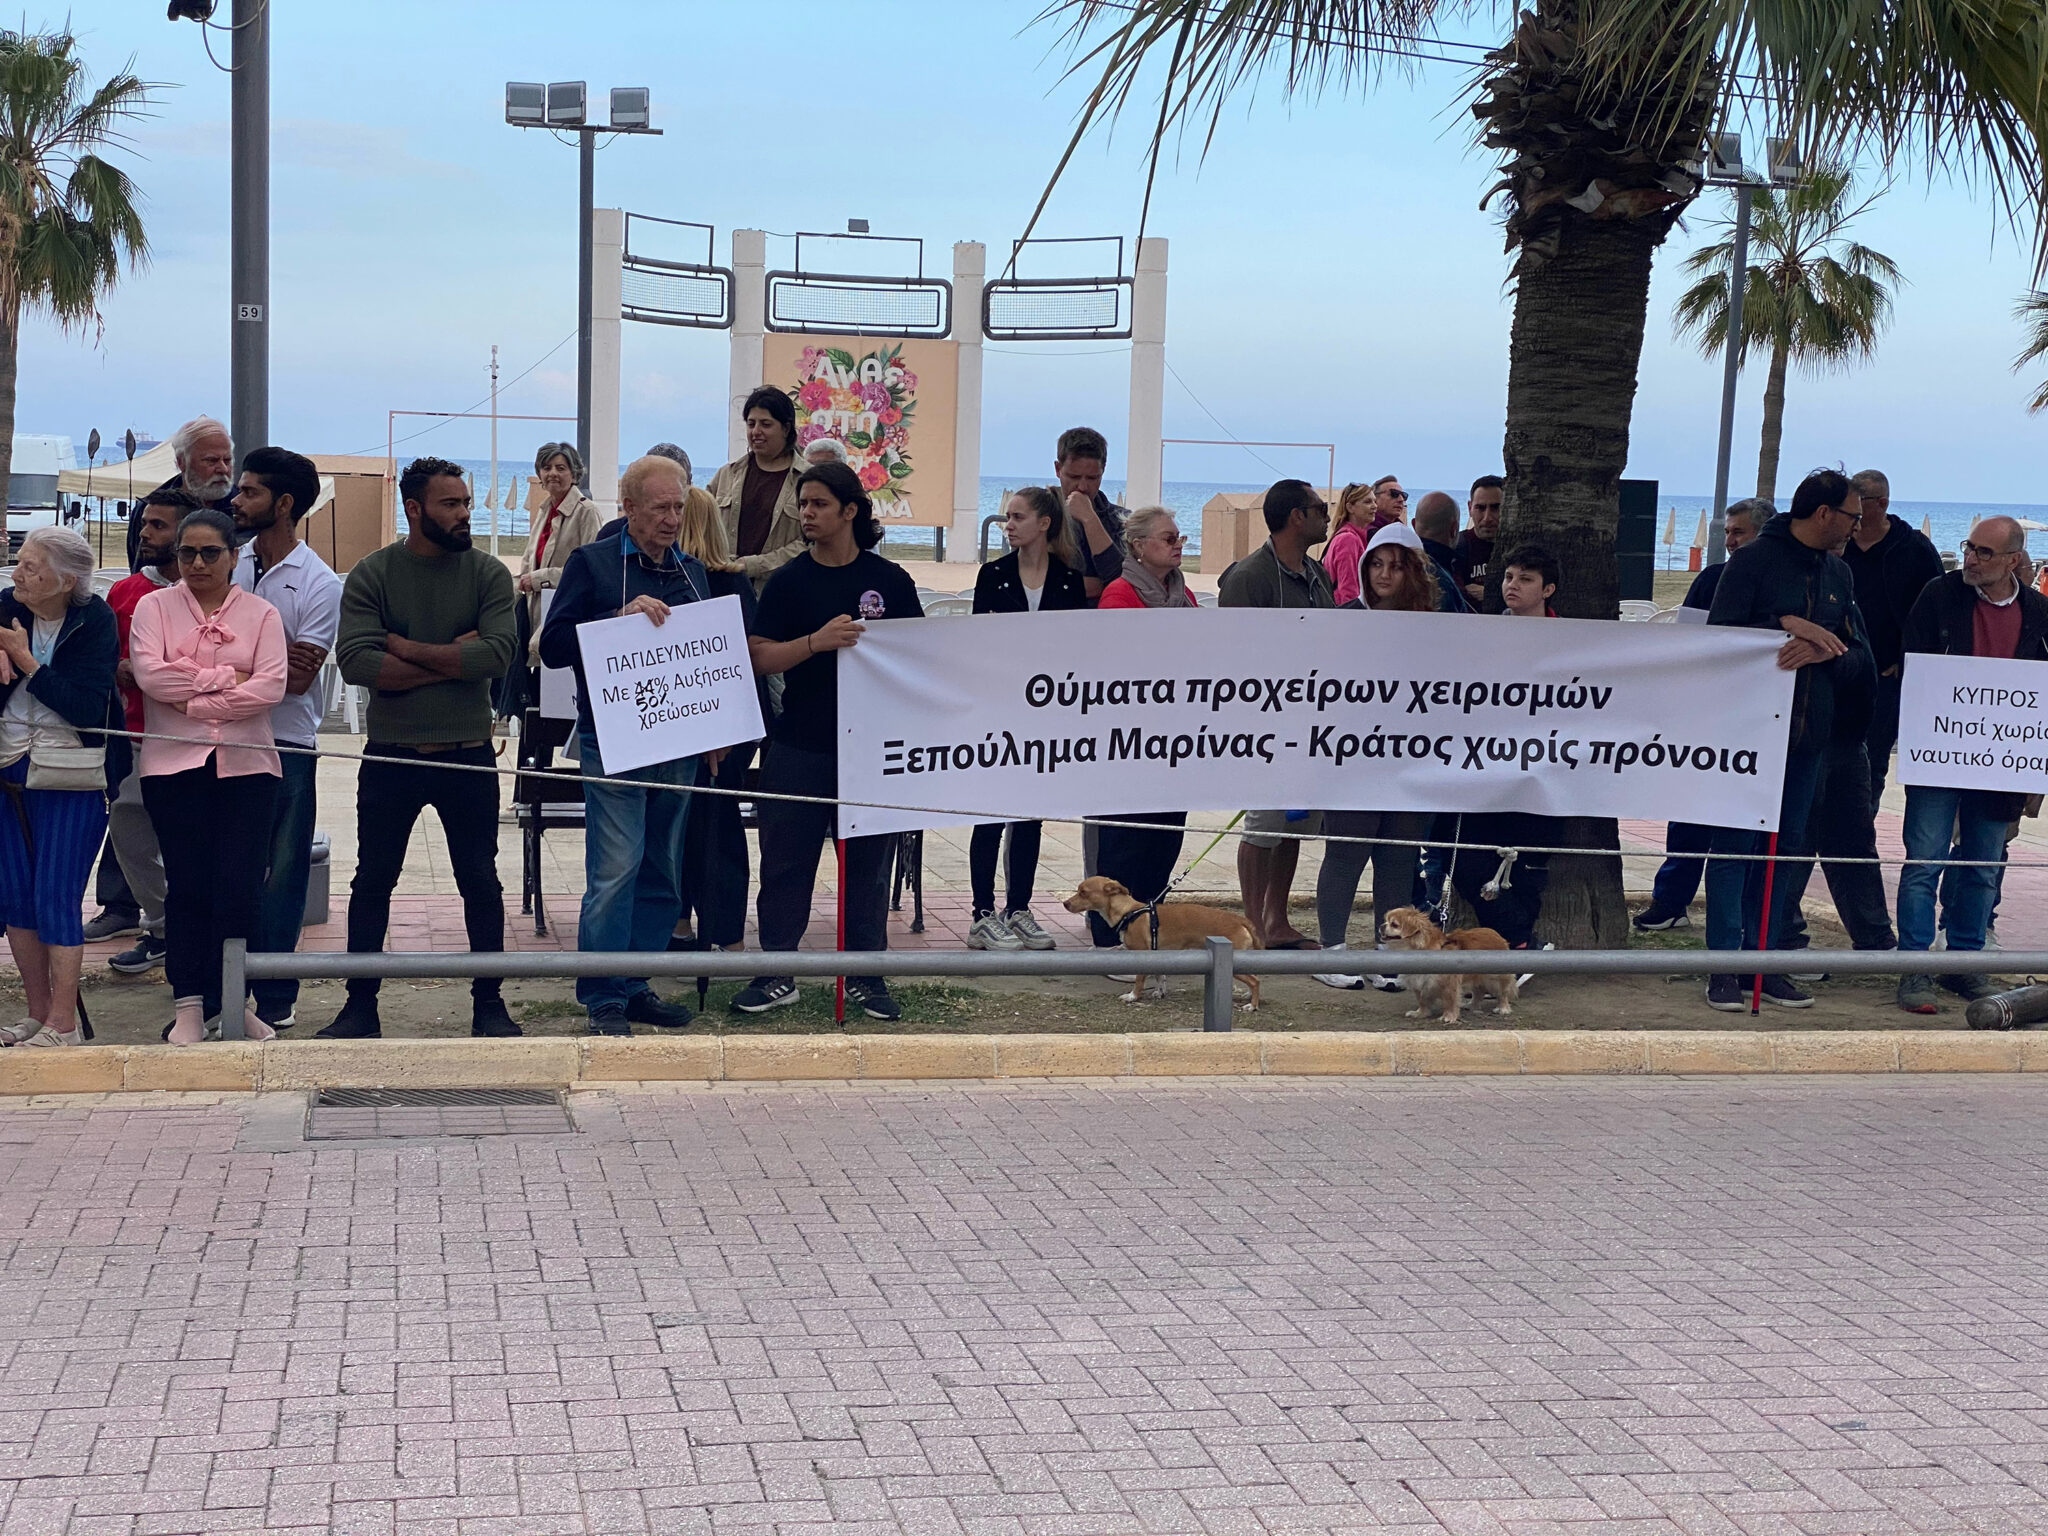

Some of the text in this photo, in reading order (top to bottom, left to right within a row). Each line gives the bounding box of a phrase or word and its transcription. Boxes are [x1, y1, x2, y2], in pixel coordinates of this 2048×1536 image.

[241, 306, 258, 318] 59
[607, 635, 727, 674] ΠΑΓΙΔΕΥΜΕΝΟΙ
[603, 686, 630, 704] Με
[674, 665, 742, 690] Αυξήσεις
[1026, 670, 1612, 715] Θύματα προχείρων χειρισμών
[1953, 687, 2039, 708] ΚΥΠΡΟΣ
[638, 698, 720, 730] χρεώσεων
[1934, 716, 1986, 738] Νησί
[883, 731, 1096, 775] Ξεπούλημα
[1108, 725, 1275, 767] Μαρίνας
[1309, 725, 1453, 766] Κράτος
[1461, 730, 1579, 770] χωρίς
[1589, 734, 1758, 775] πρόνοια
[1910, 748, 1994, 767] ναυτικό
